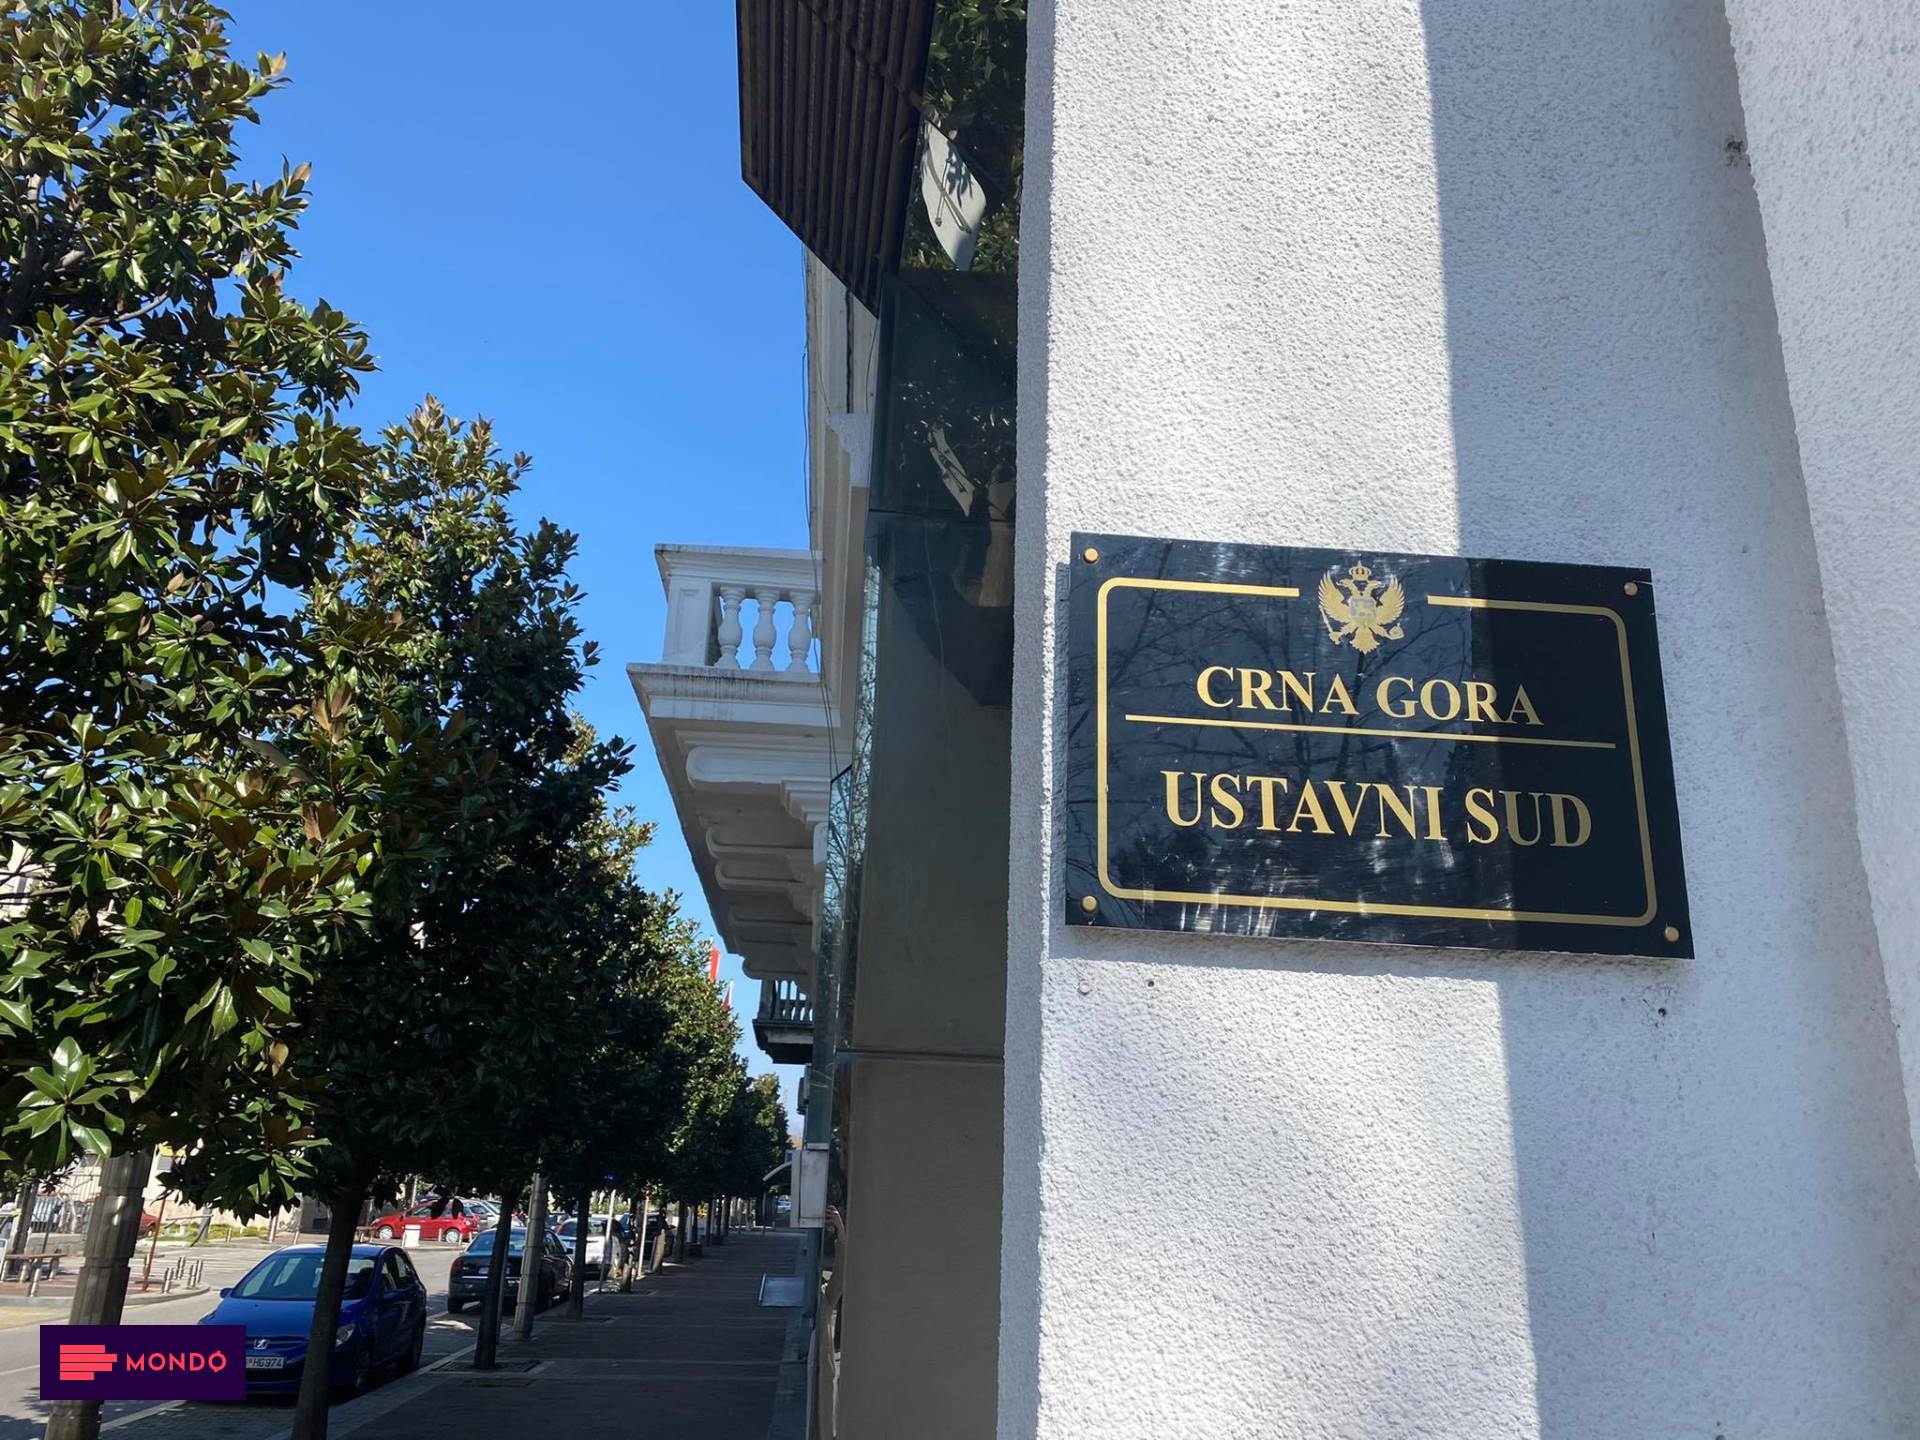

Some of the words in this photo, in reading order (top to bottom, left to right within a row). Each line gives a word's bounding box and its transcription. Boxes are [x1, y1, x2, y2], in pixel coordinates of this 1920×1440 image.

[1196, 665, 1360, 715] CRNA
[1376, 676, 1545, 726] GORA
[1160, 770, 1449, 841] USTAVNI
[1464, 787, 1592, 848] SUD
